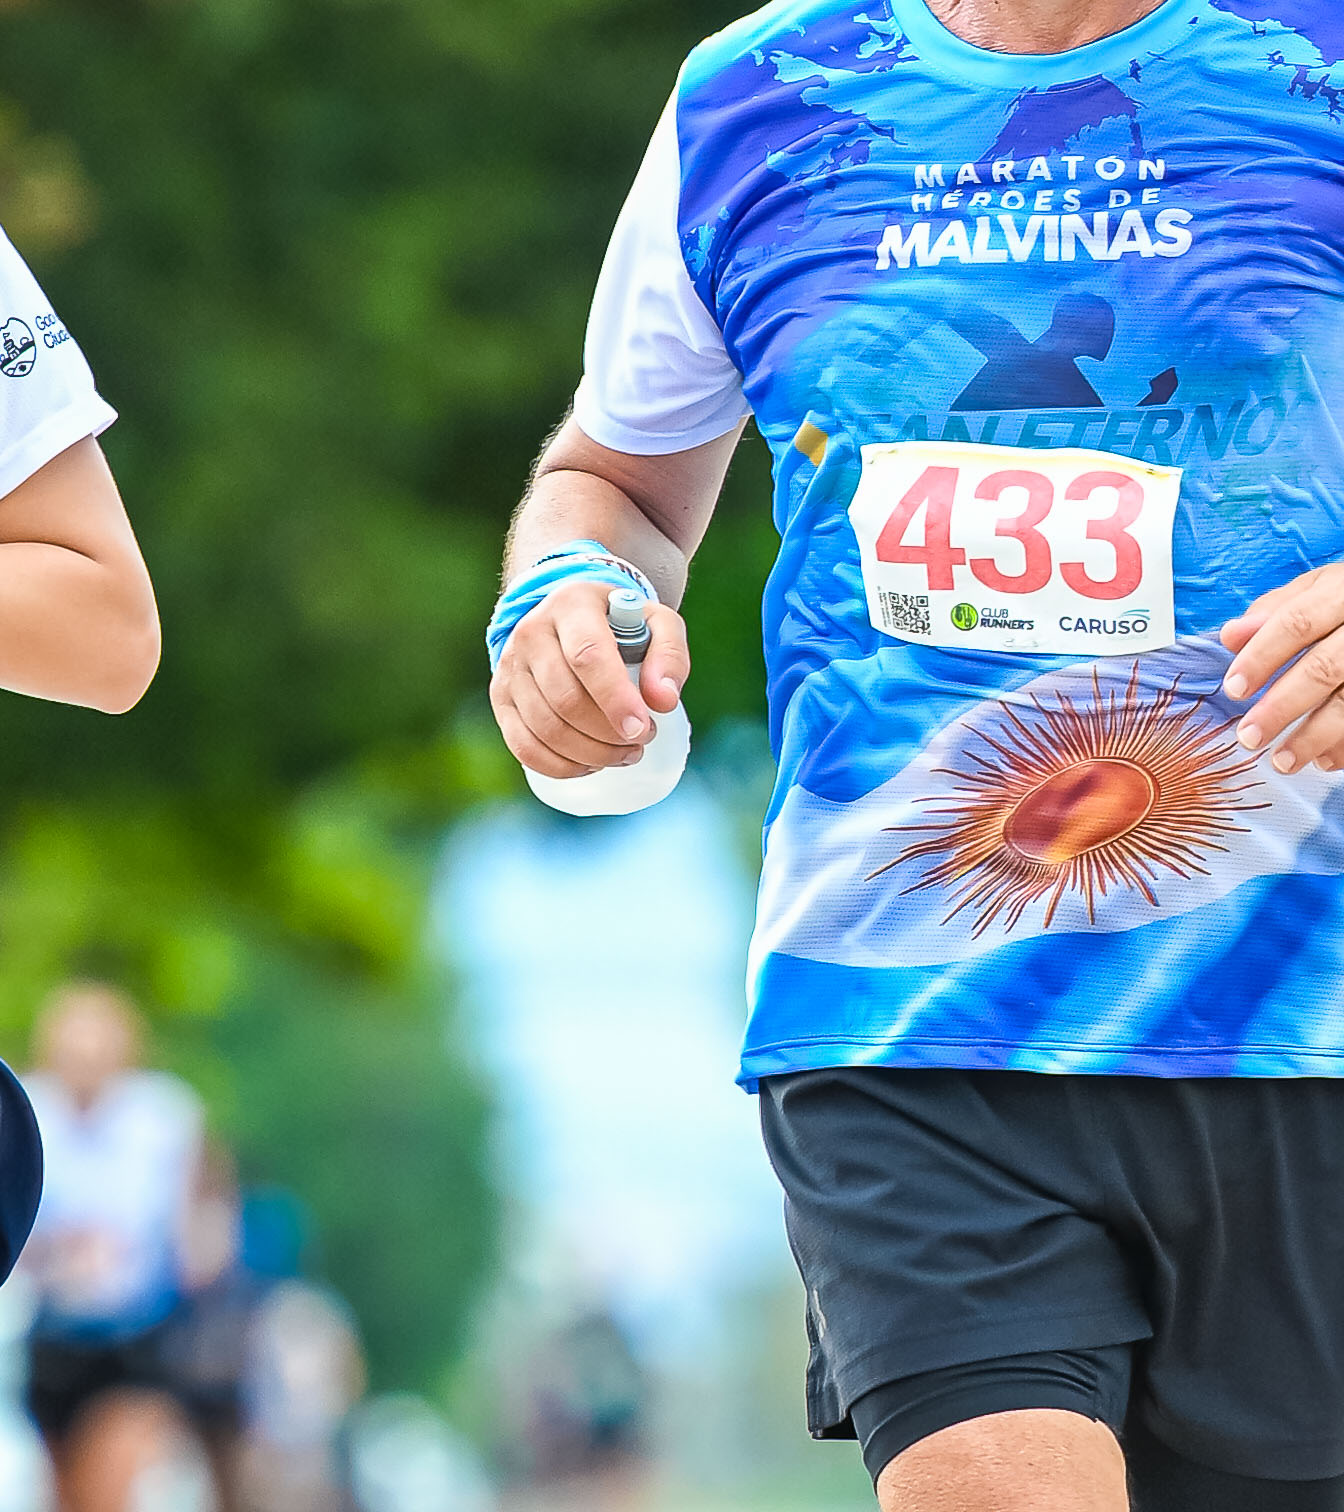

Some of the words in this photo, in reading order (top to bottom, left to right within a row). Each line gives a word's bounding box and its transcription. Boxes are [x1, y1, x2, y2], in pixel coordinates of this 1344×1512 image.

[913, 155, 1166, 190] MARATÓN
[910, 188, 1082, 213] HÉROES
[1107, 187, 1162, 210] DE
[875, 208, 1194, 271] MALVINAS
[875, 465, 1145, 601] 433
[981, 607, 1009, 619] CLUB
[1058, 616, 1148, 635] CARUSO
